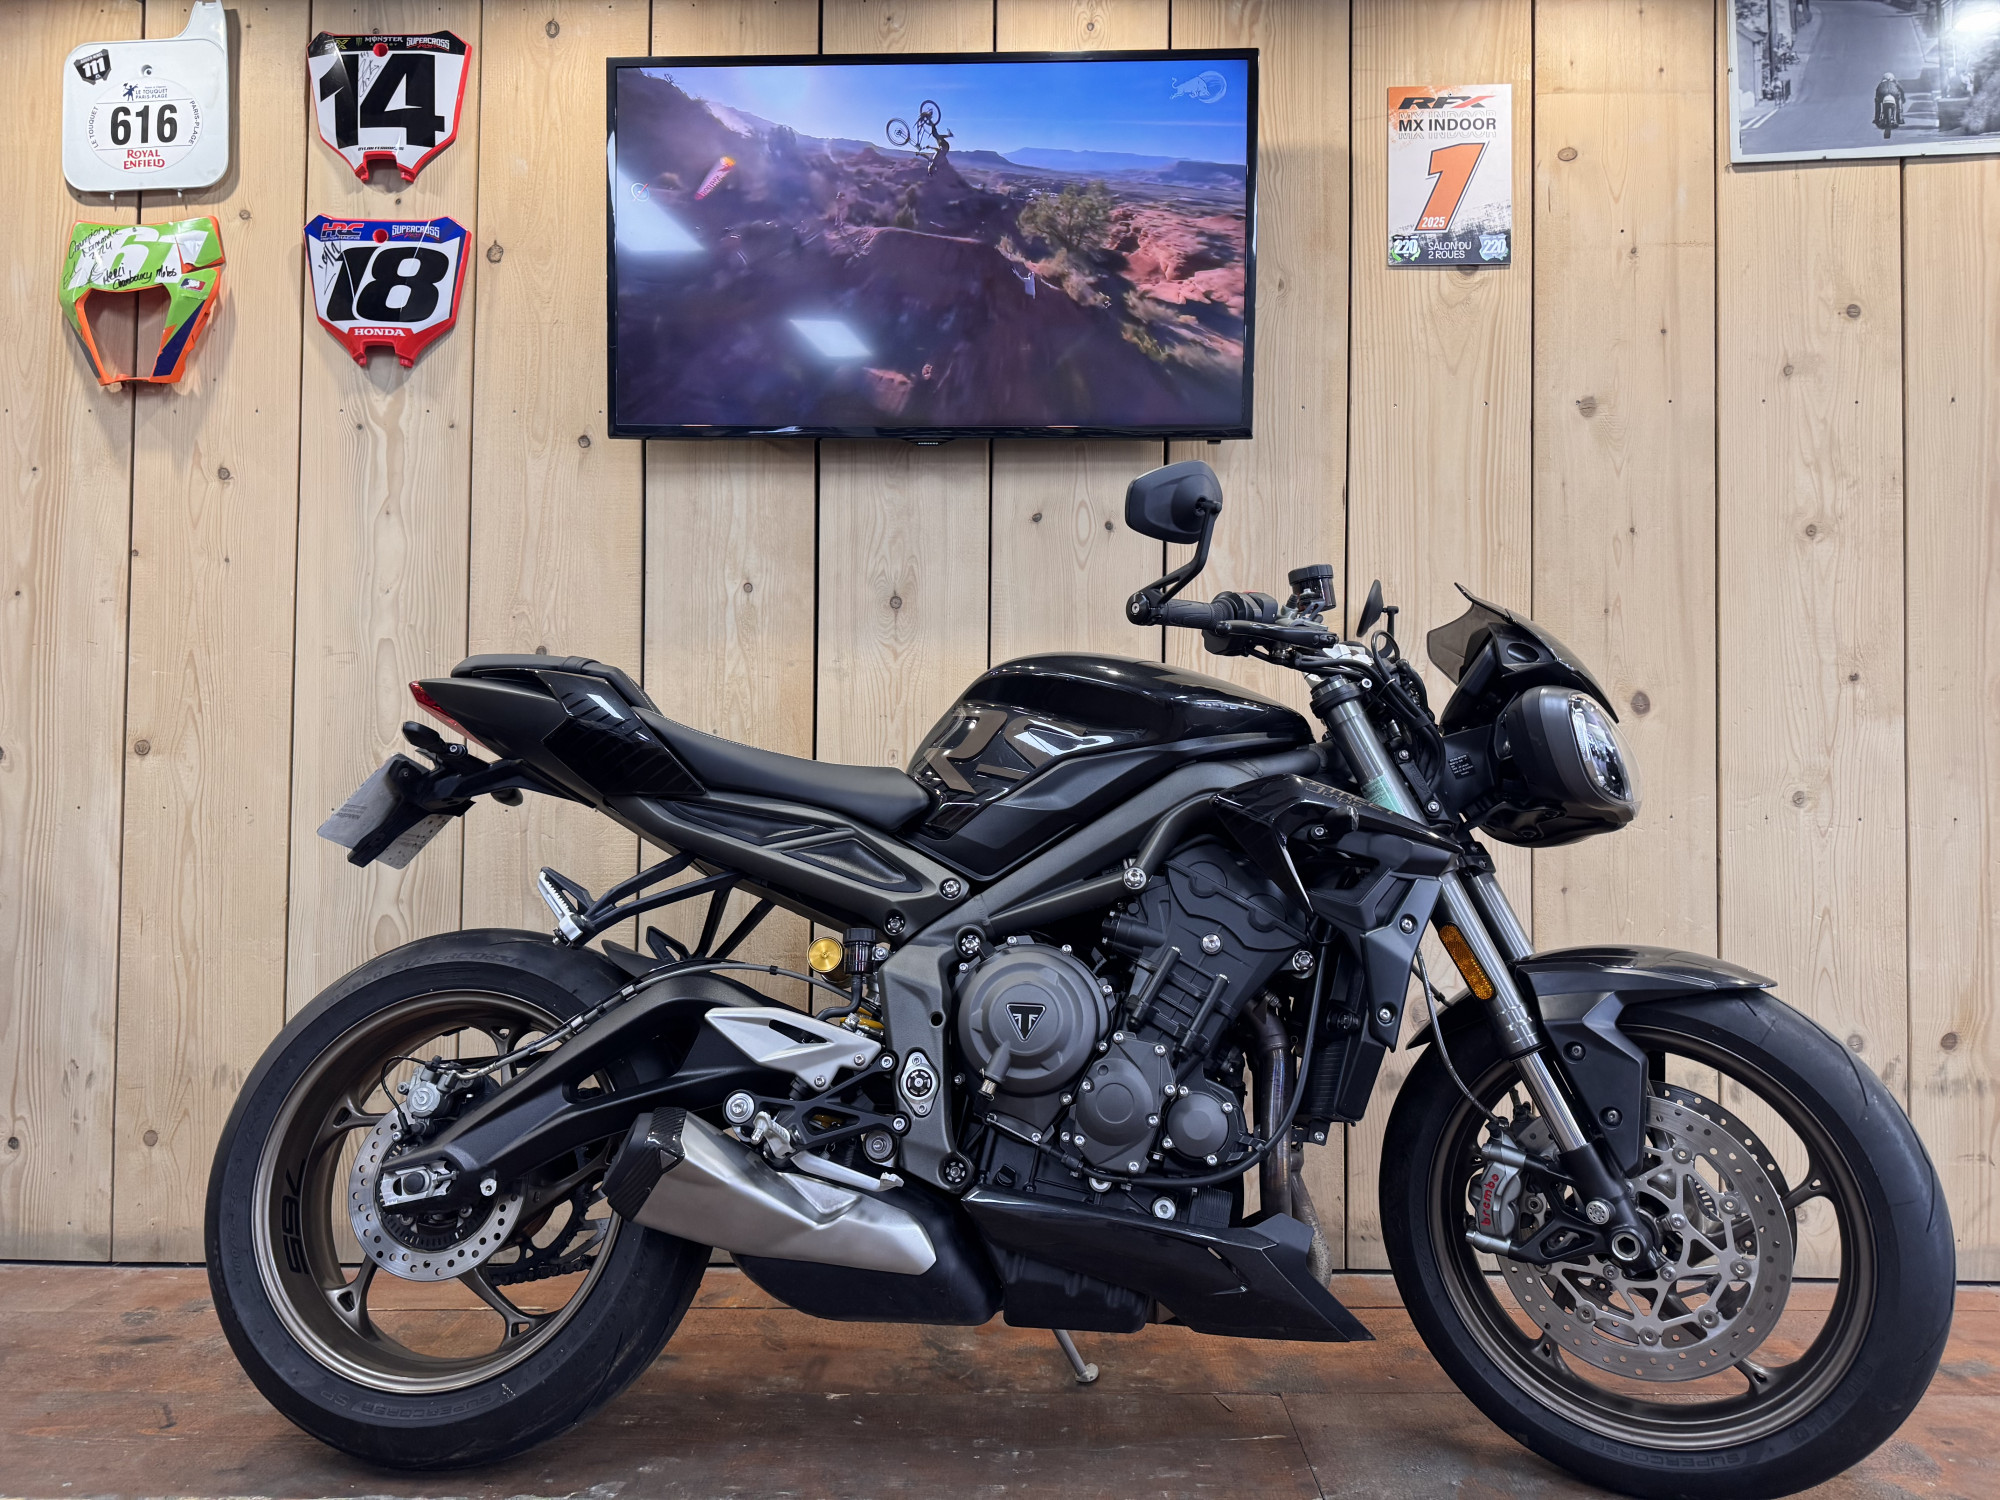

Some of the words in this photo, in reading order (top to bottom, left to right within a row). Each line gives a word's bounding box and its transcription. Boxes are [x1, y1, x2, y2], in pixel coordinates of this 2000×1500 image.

[406, 37, 450, 50] SUPERCROSS
[82, 57, 106, 78] 111
[319, 53, 446, 150] 14
[88, 106, 99, 139] TOUQUET
[110, 104, 178, 146] 616
[188, 100, 200, 144] PARIS-PLAGE
[1398, 119, 1424, 132] MX
[1428, 117, 1497, 131] INDOOR
[90, 139, 99, 149] LE
[126, 149, 161, 160] ROYAL
[123, 158, 166, 170] ENFIELD
[1414, 142, 1486, 232] 1
[320, 222, 365, 238] HRC
[1421, 216, 1446, 228] 2025
[392, 225, 440, 239] SUPERCROSS
[1393, 239, 1419, 254] 220
[1428, 242, 1457, 250] SALON
[1458, 241, 1472, 250] DU
[1483, 239, 1507, 254] 220
[1428, 251, 1434, 259] 2
[1435, 250, 1465, 259] ROUES
[326, 246, 450, 323] 18
[354, 328, 406, 337] HONDA
[1480, 1173, 1500, 1227] brembo
[281, 1158, 310, 1275] 765
[318, 1388, 351, 1407] SP
[360, 1393, 492, 1419] SUPERCORSA
[1590, 1437, 1741, 1470] SUPERCORSA
